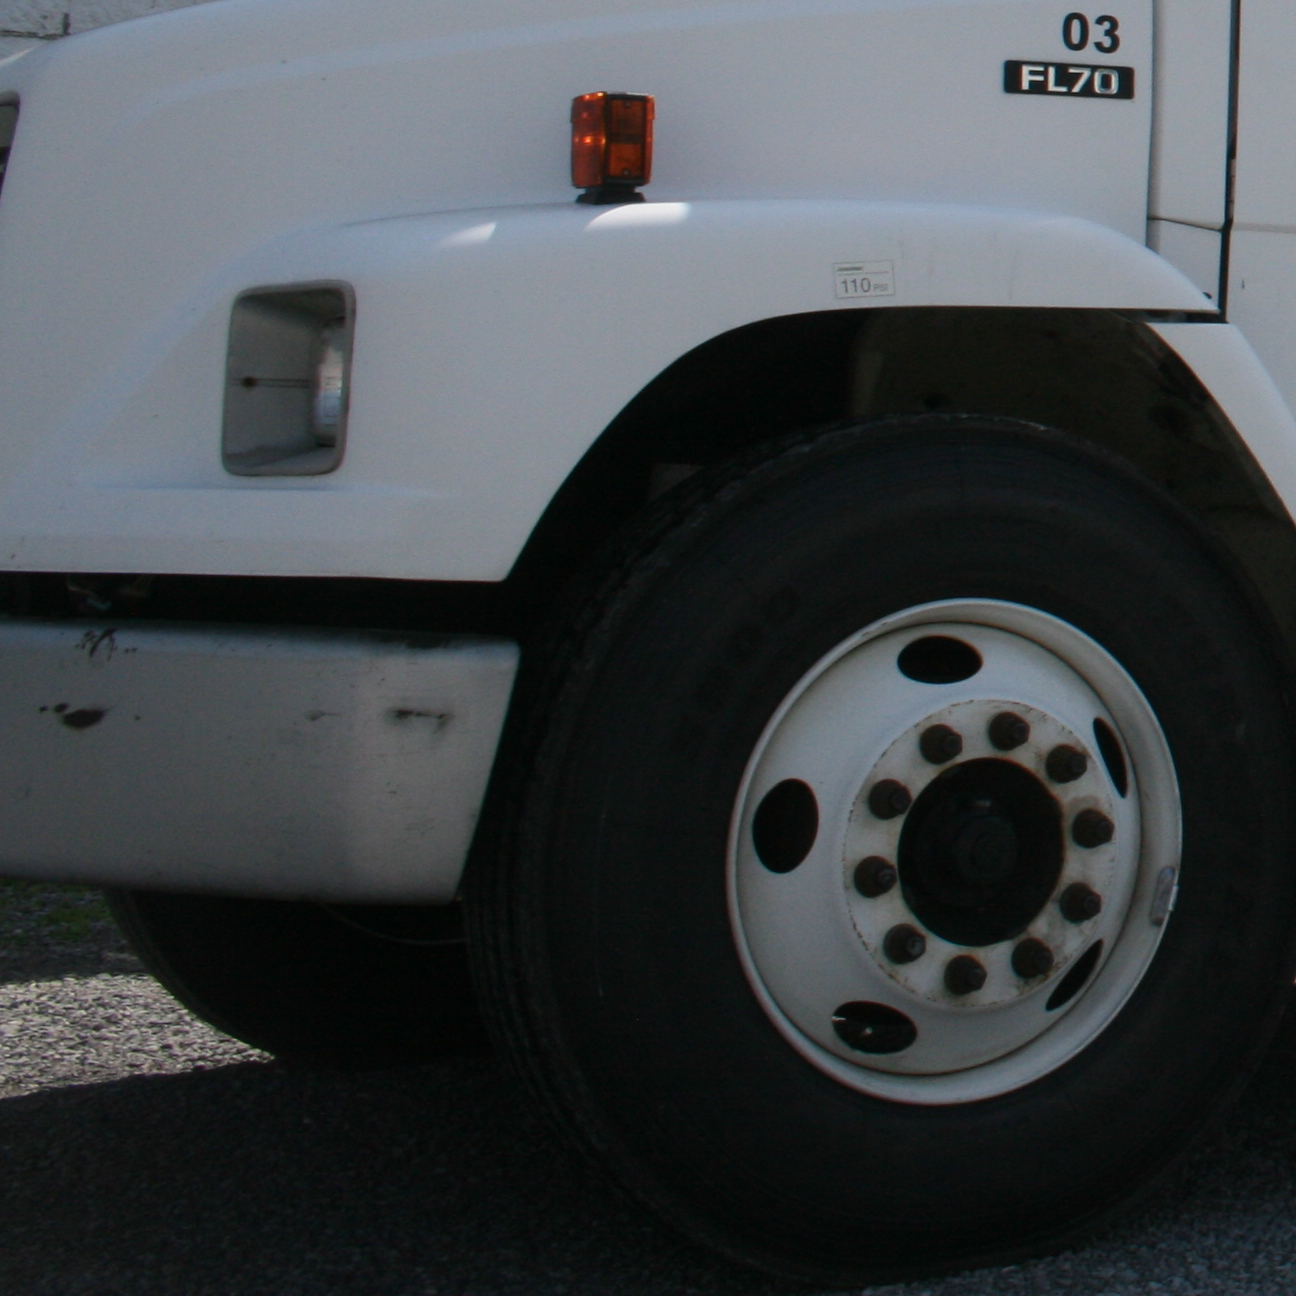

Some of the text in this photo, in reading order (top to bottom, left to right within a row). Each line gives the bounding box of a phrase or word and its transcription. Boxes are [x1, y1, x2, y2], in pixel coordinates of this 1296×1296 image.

[1062, 12, 1121, 54] 03
[1020, 64, 1120, 95] FL70
[841, 277, 871, 294] 110
